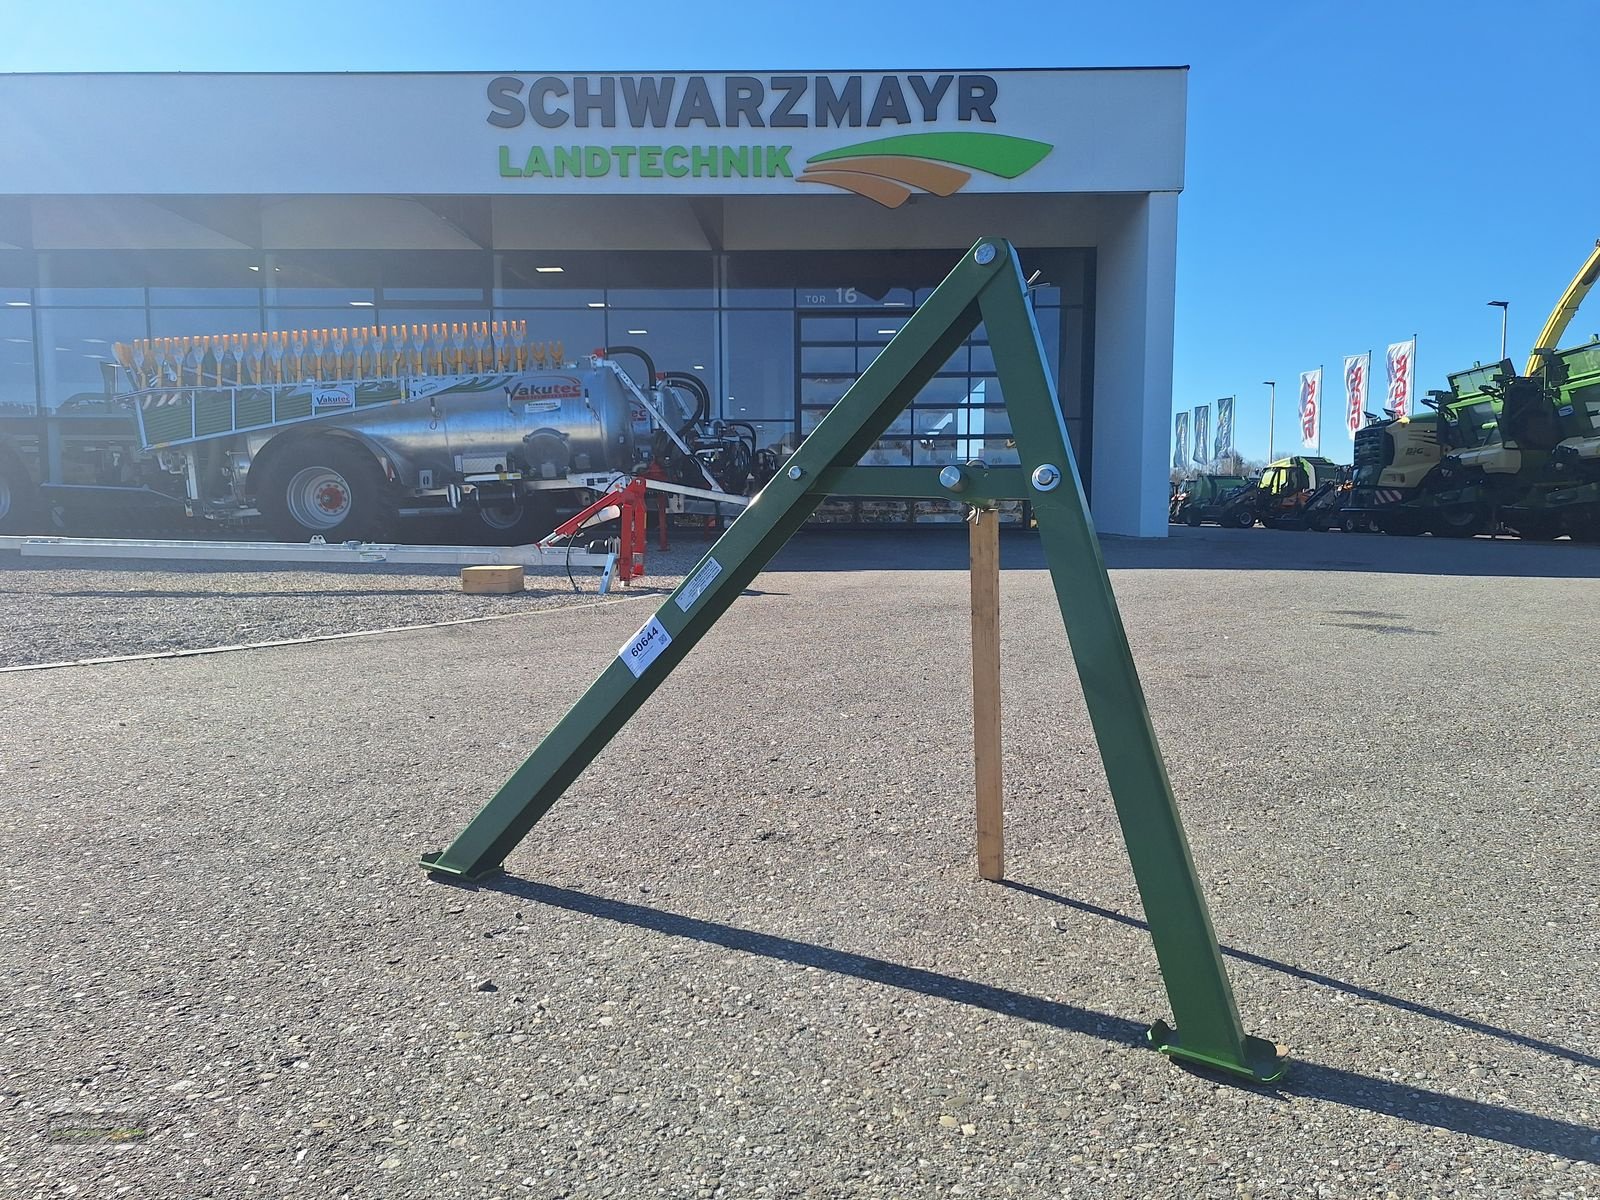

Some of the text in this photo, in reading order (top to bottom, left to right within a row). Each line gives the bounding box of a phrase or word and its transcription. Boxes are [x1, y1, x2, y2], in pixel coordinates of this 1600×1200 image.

[486, 74, 998, 128] SCHWARZMAYR
[499, 145, 793, 178] LANDTECHNIK
[805, 287, 857, 304] TOR 16
[316, 394, 351, 405] Vakutec
[503, 382, 582, 400] Vakutec
[631, 626, 659, 657] 60644
